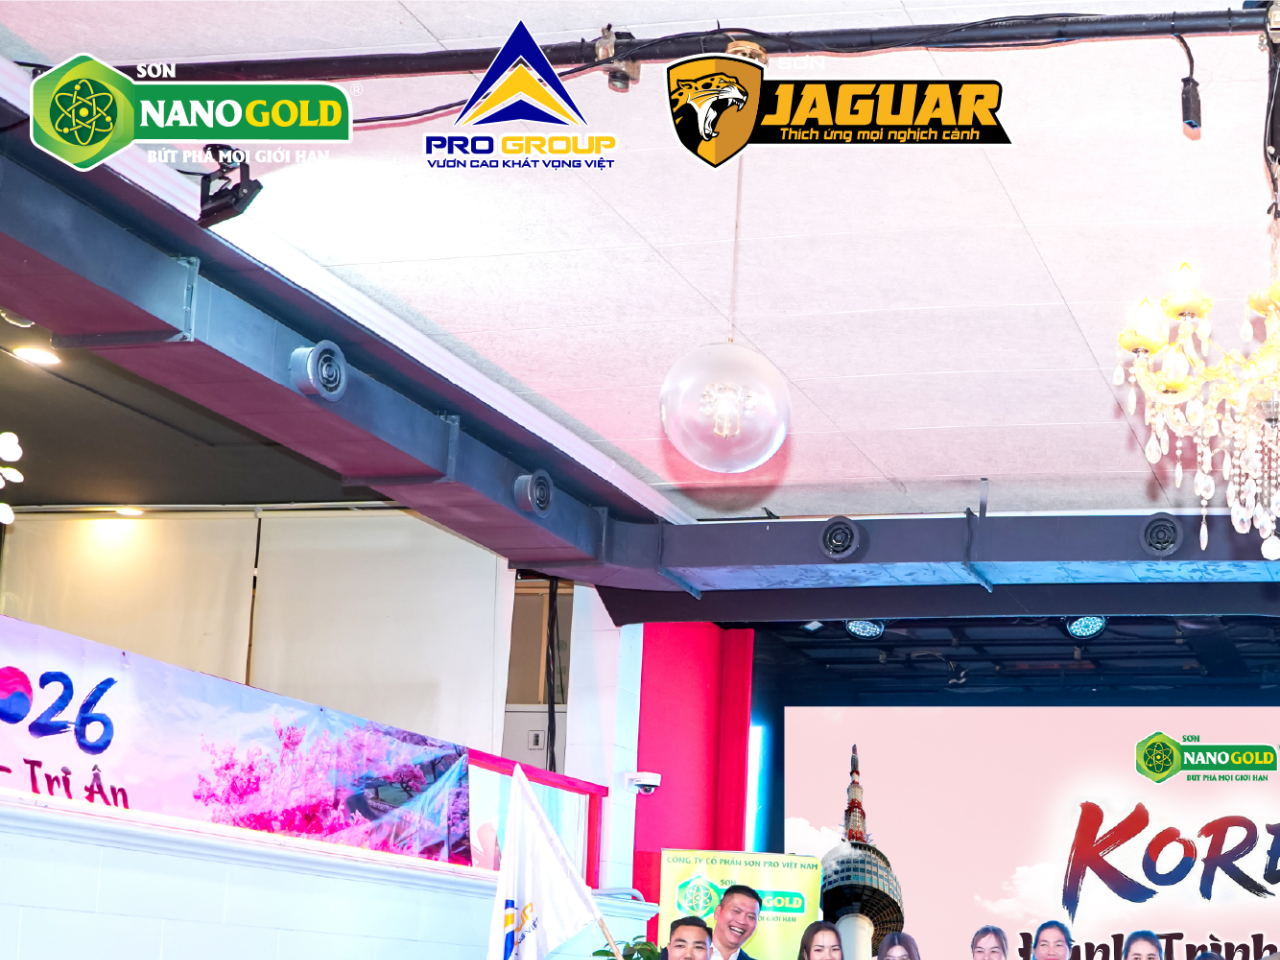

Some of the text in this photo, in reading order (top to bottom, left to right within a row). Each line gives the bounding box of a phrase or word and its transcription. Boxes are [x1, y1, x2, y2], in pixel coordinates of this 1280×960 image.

[1182, 734, 1200, 743] SƠN
[23, 757, 73, 800] Tri
[84, 764, 130, 809] Ân
[667, 856, 691, 864] CÔNG
